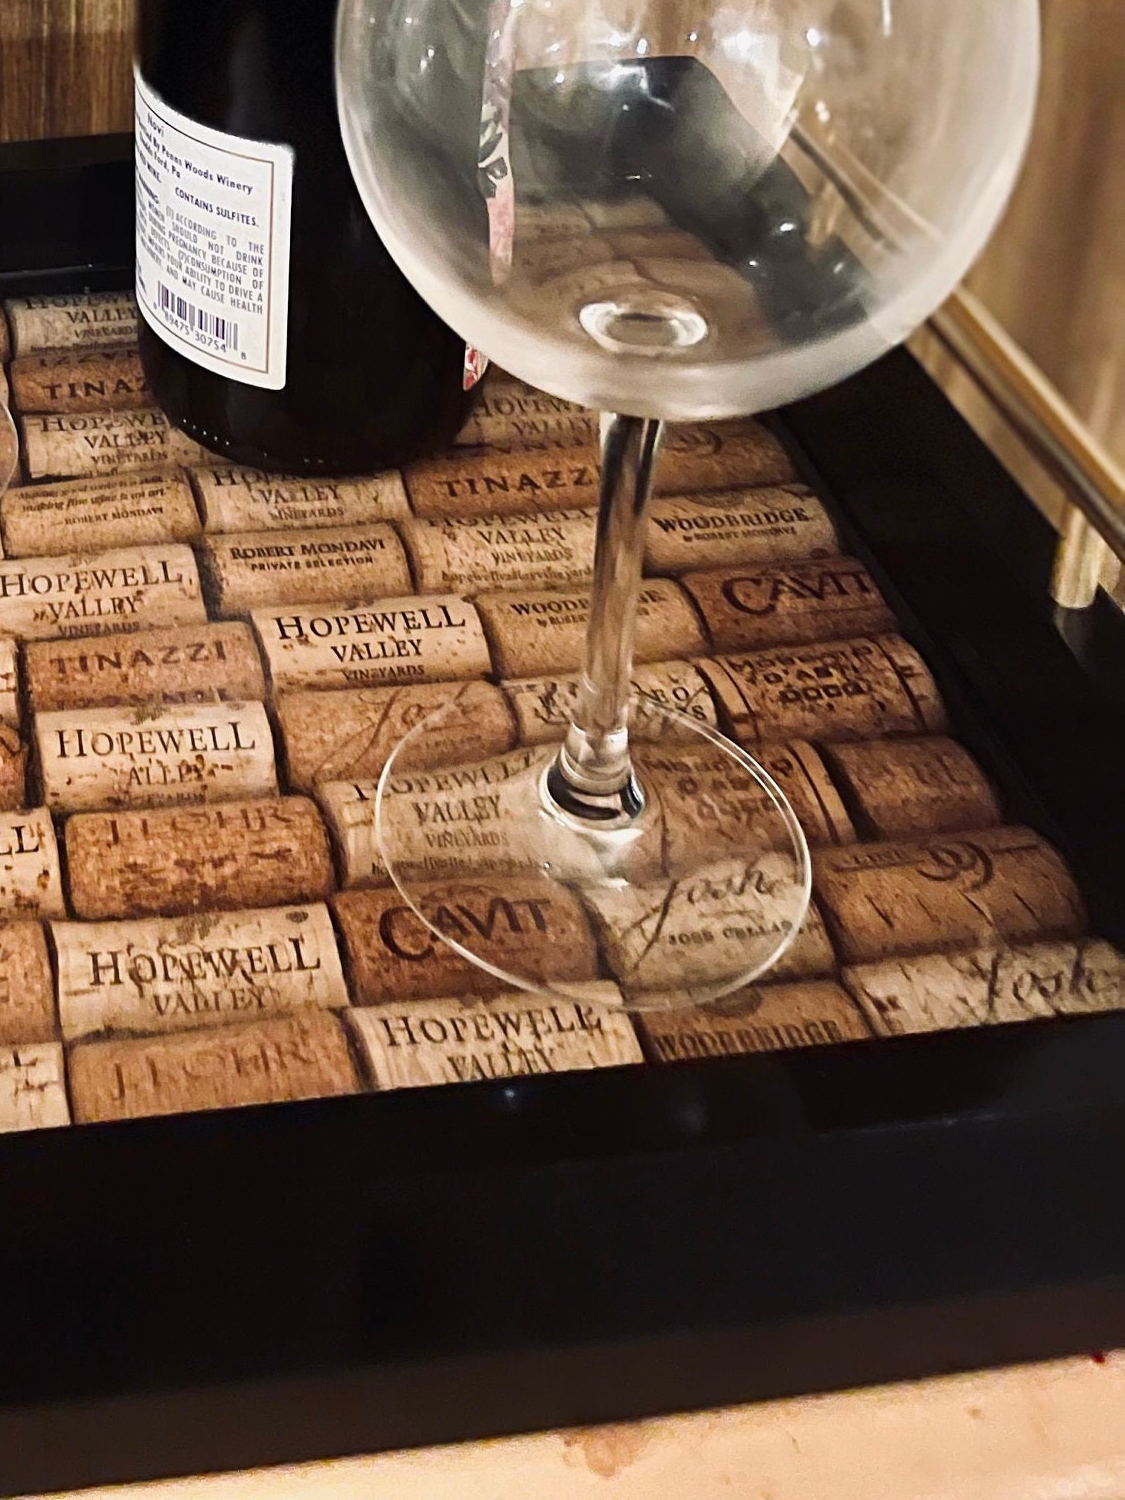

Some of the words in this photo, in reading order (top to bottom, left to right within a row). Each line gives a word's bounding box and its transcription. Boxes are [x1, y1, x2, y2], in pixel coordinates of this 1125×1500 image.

[184, 159, 214, 181] Woods
[216, 173, 253, 196] Winery
[174, 186, 214, 213] CONTAINS
[168, 230, 206, 260] PREGNANCY
[211, 254, 247, 276] BECAUSE
[252, 267, 263, 278] OF
[171, 220, 198, 244] SHOULD
[207, 240, 224, 255] NOT
[236, 250, 263, 266] DRINK
[226, 235, 237, 247] TO
[248, 241, 264, 255] THE
[184, 265, 212, 286] ABILITY
[215, 279, 225, 292] TO
[228, 284, 254, 301] DRIVE
[252, 279, 264, 290] OF
[200, 285, 225, 305] CAUSE
[230, 297, 263, 315] HEALTH
[194, 331, 227, 353] 30754
[83, 429, 167, 450] VALLEY
[653, 507, 809, 534] WOODBRIDGE
[230, 545, 296, 560] ROBERT
[300, 538, 386, 556] MONDAVI
[479, 526, 567, 546] VALLEY
[251, 560, 302, 572] PRIVATE
[305, 555, 374, 569] SELECTION
[0, 560, 184, 598] HOPEWELL
[47, 594, 139, 622] VALLEY
[274, 604, 467, 641] HOPEWELL
[49, 639, 226, 675] TINAZZI
[330, 638, 424, 664] VALLEY
[343, 664, 426, 682] VINEYARDS
[55, 721, 256, 759] HOPEWELL
[412, 794, 502, 822] VALLEY
[379, 896, 551, 962] CAVIT
[86, 935, 321, 987] HOPEWELL
[378, 1002, 603, 1047] HOPEWELL
